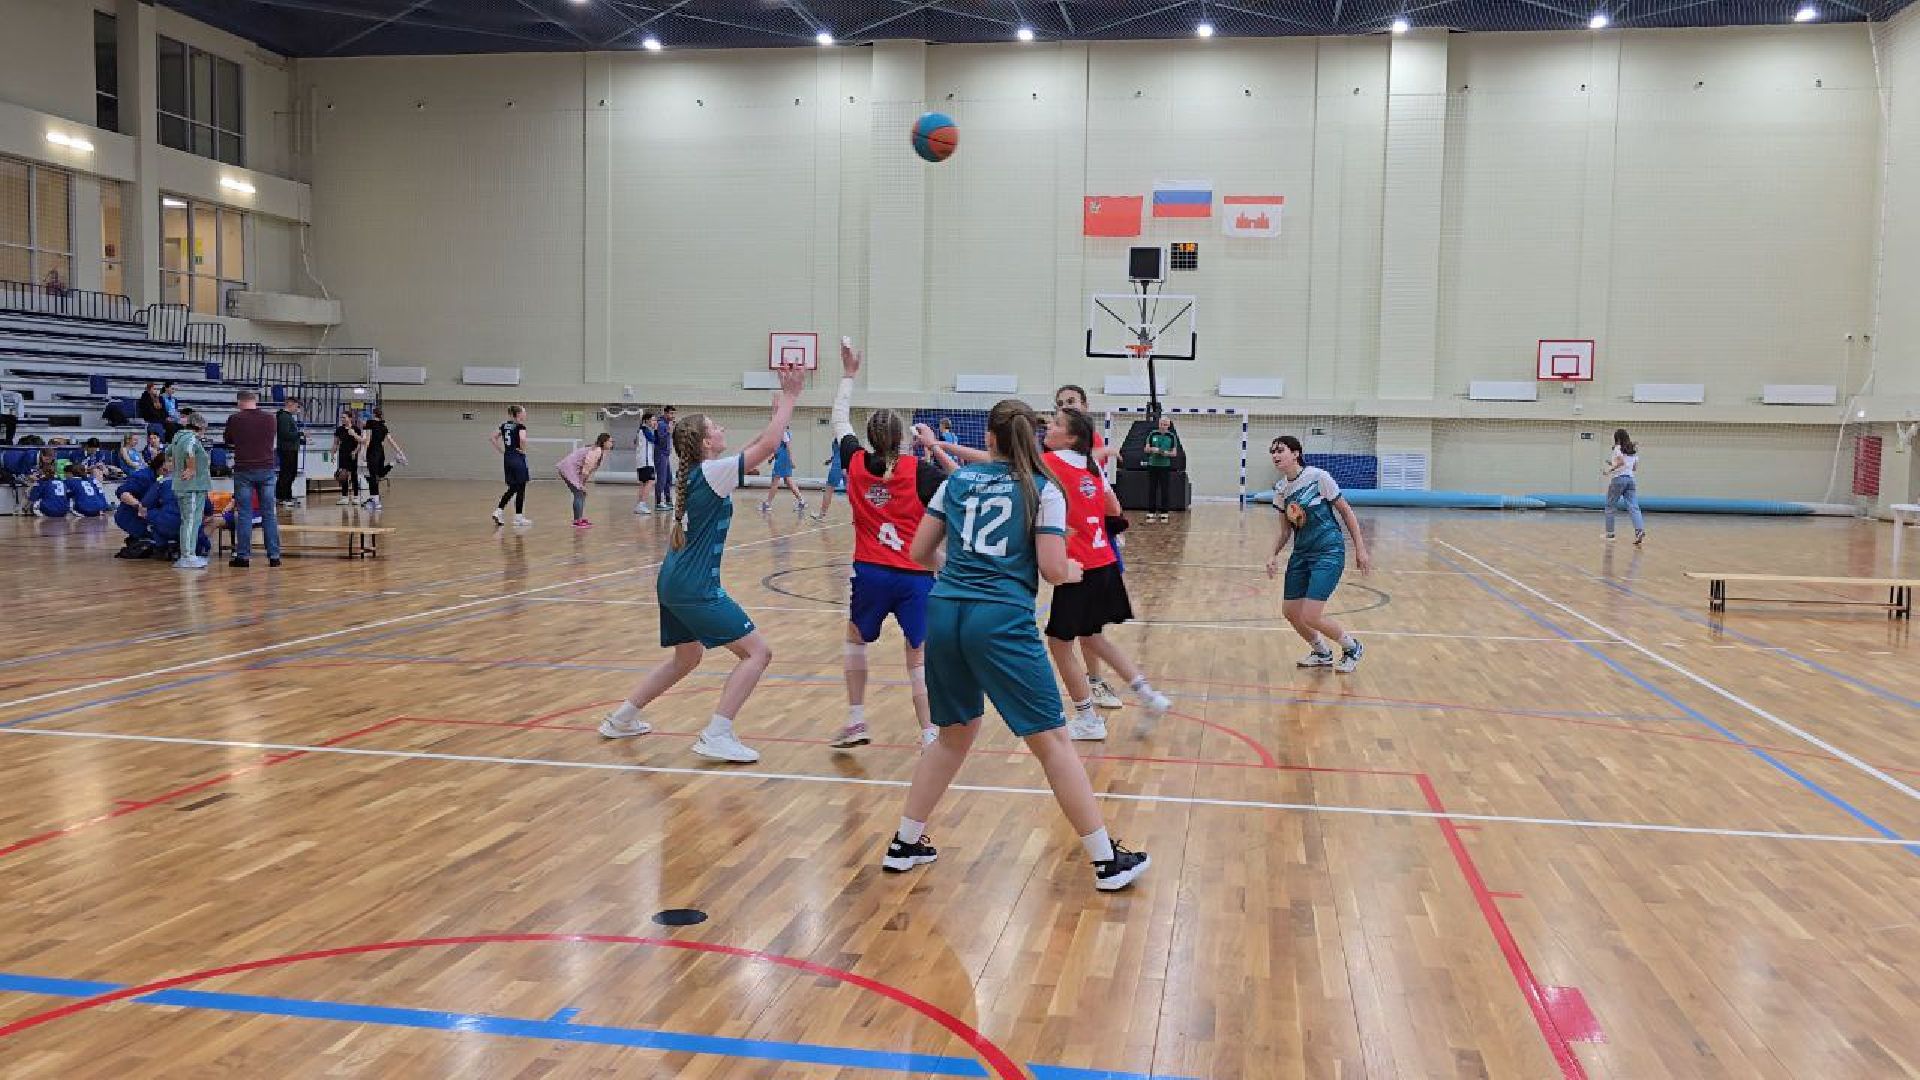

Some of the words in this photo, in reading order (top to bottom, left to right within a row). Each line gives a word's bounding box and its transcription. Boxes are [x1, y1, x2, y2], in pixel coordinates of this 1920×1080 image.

[504, 430, 512, 446] 5
[878, 523, 905, 551] 4
[961, 496, 1012, 557] 12
